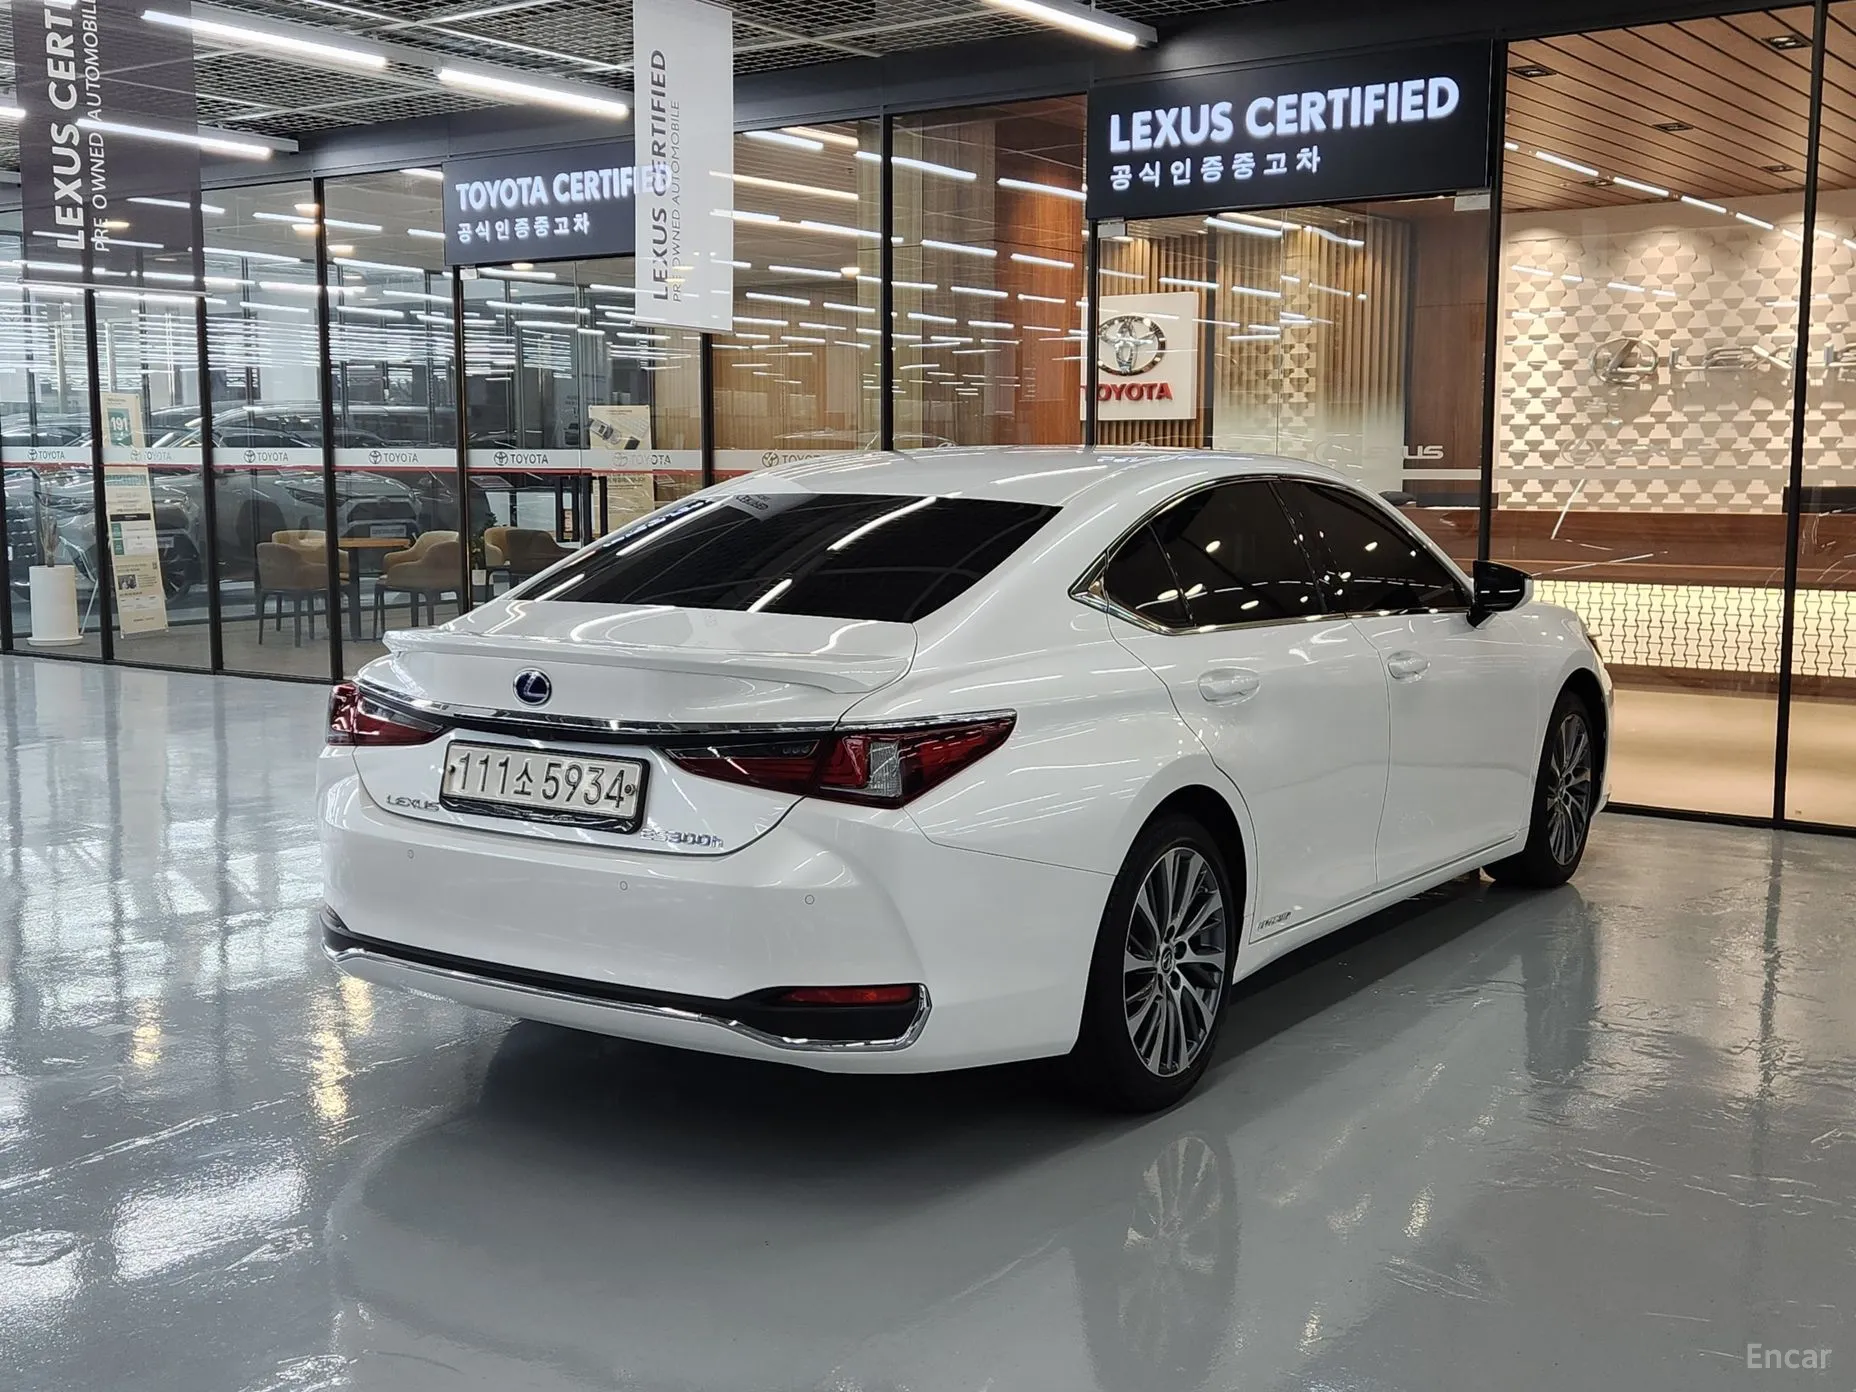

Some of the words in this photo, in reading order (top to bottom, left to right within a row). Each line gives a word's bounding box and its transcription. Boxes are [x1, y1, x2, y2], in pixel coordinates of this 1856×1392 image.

[650, 49, 667, 197] CERTIFIED
[1110, 102, 1234, 152] LEXUS
[1245, 76, 1460, 139] CERTIFIED
[670, 100, 680, 205] AUTOMOBILE
[51, 122, 85, 250] LEXUS
[88, 132, 108, 210] OWNED
[456, 176, 549, 211] TOYOTA
[92, 217, 110, 252] PRE
[652, 207, 668, 300] LEXUS
[110, 416, 129, 431] 191
[38, 450, 65, 460] TOYOTA
[257, 452, 289, 462] TOYOTA
[384, 453, 419, 463] TOYOTA
[510, 453, 549, 464] TOYOTA
[630, 454, 671, 465] TOYOTA
[386, 794, 440, 812] LEXUS
